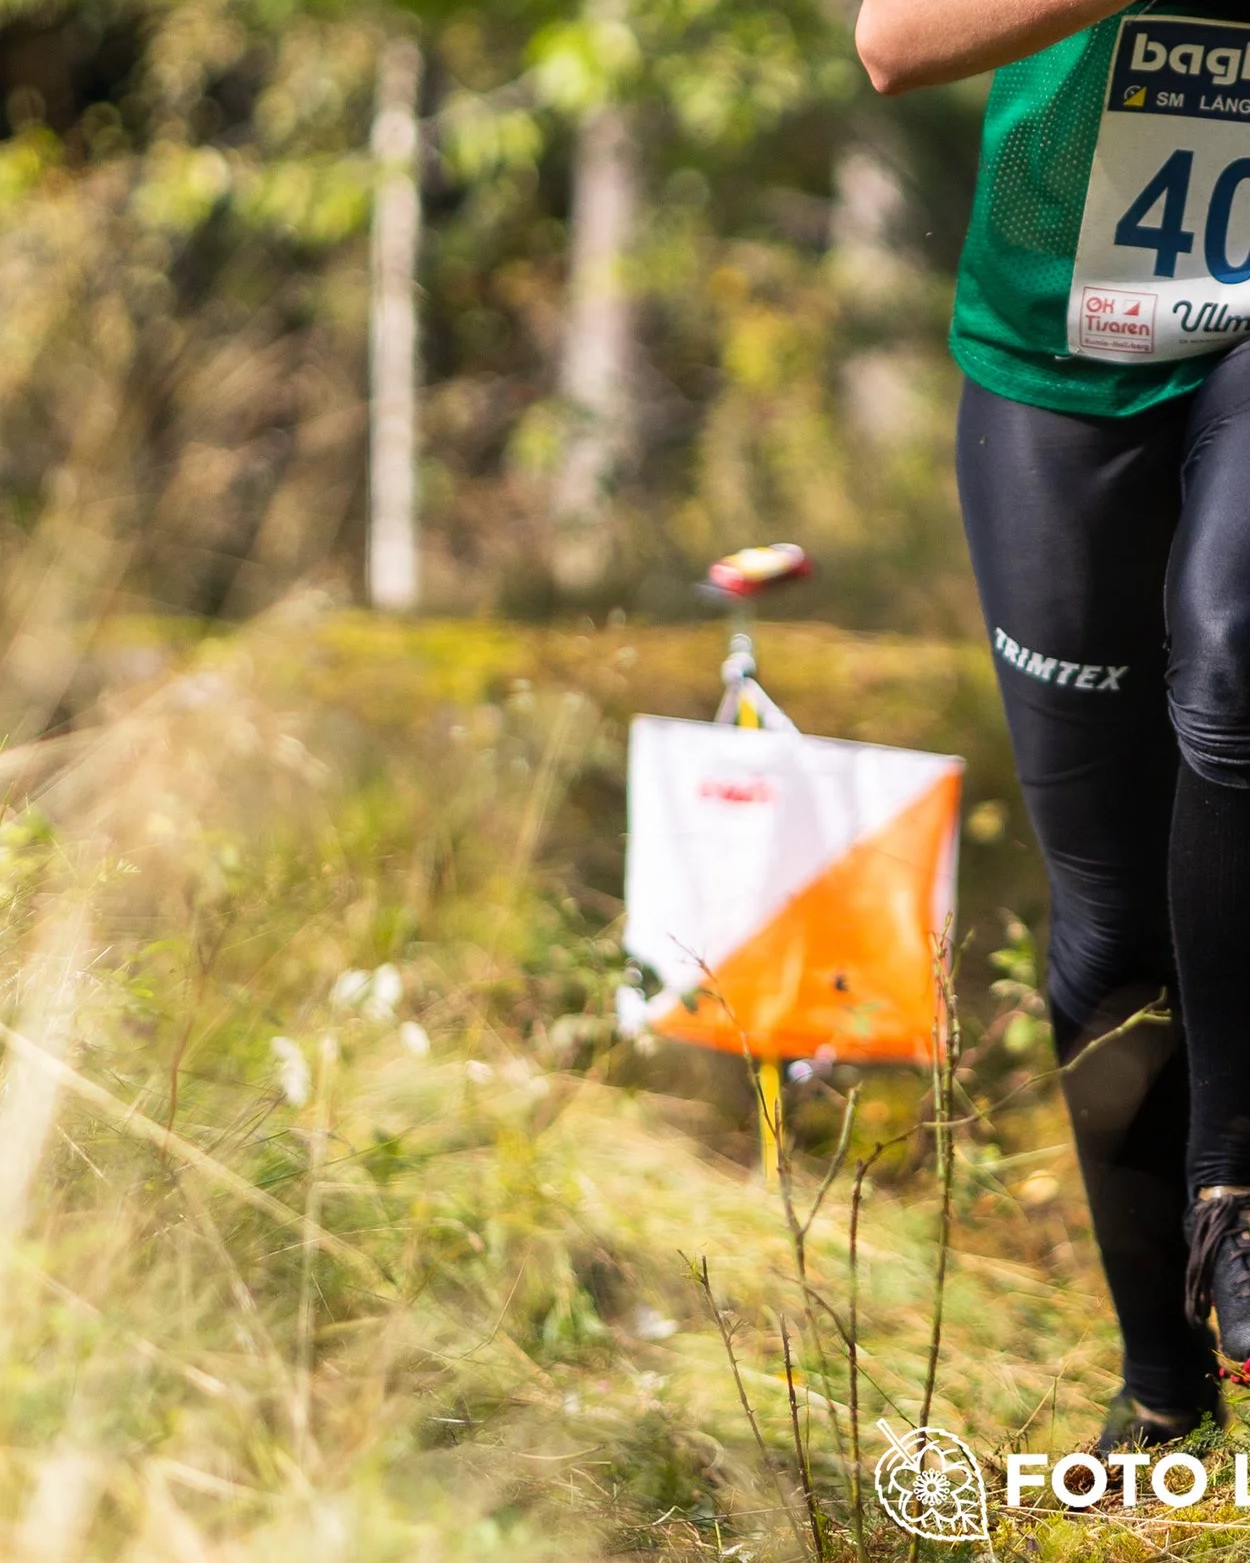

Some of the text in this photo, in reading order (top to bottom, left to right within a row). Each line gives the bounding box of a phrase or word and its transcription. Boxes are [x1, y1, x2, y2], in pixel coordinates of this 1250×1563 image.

[1155, 91, 1185, 108] SM
[1086, 296, 1115, 314] OK
[1085, 315, 1150, 336] Tisaren
[995, 626, 1129, 690] TRIMTEX
